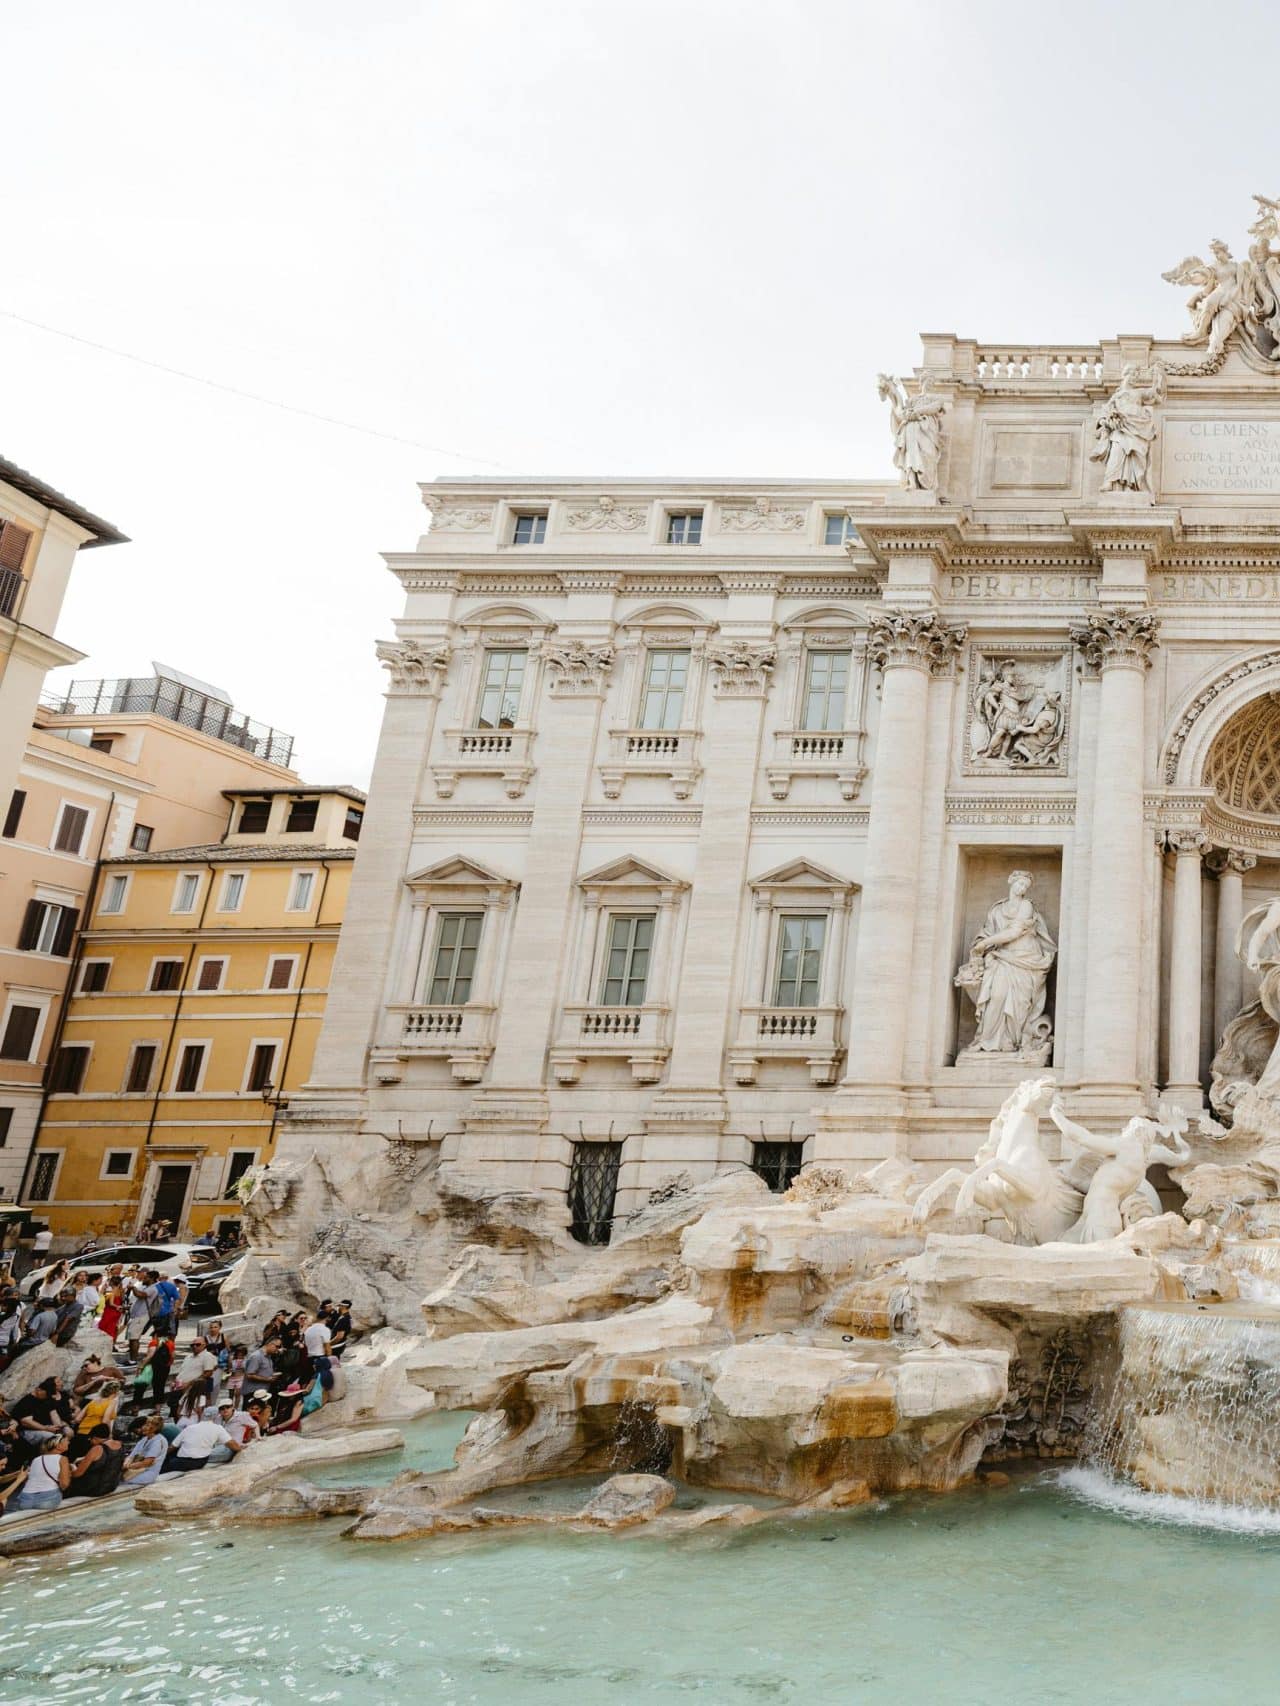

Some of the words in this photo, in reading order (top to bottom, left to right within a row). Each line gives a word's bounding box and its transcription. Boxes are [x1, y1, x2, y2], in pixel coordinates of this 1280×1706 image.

[1190, 423, 1269, 437] CLEMENS
[1174, 451, 1213, 463] COPIA
[1219, 452, 1234, 463] ET
[1179, 479, 1219, 489] ANNO
[1224, 479, 1273, 489] DOMINI
[948, 575, 1099, 599] PERFECIT
[946, 814, 985, 825] POSITIS
[1030, 814, 1043, 825] ET
[1049, 814, 1074, 825] ANA
